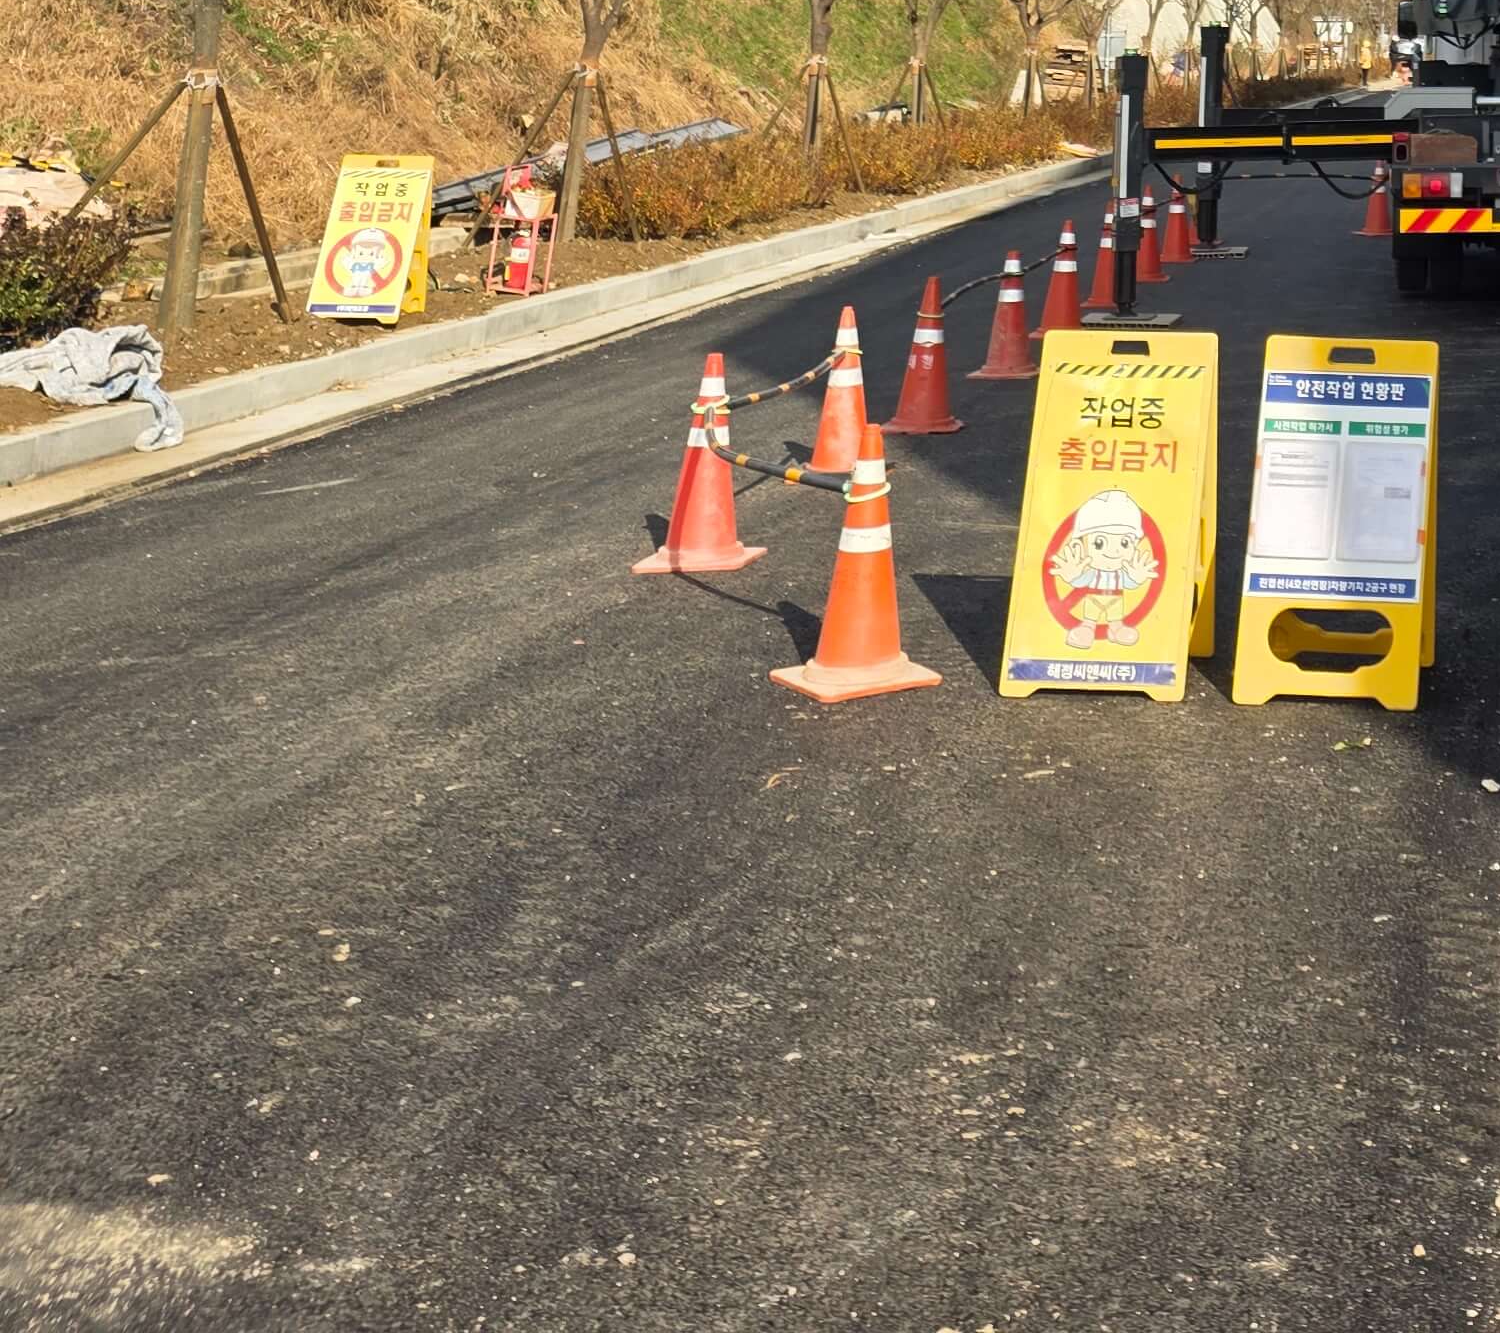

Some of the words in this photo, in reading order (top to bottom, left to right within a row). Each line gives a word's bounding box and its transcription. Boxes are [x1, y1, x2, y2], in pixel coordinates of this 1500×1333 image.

[338, 201, 414, 224] 출입금지
[1295, 379, 1356, 400] 안전작업
[1360, 382, 1406, 401] 현황판
[1080, 396, 1166, 429] 작업중
[1057, 437, 1179, 474] 출입금지
